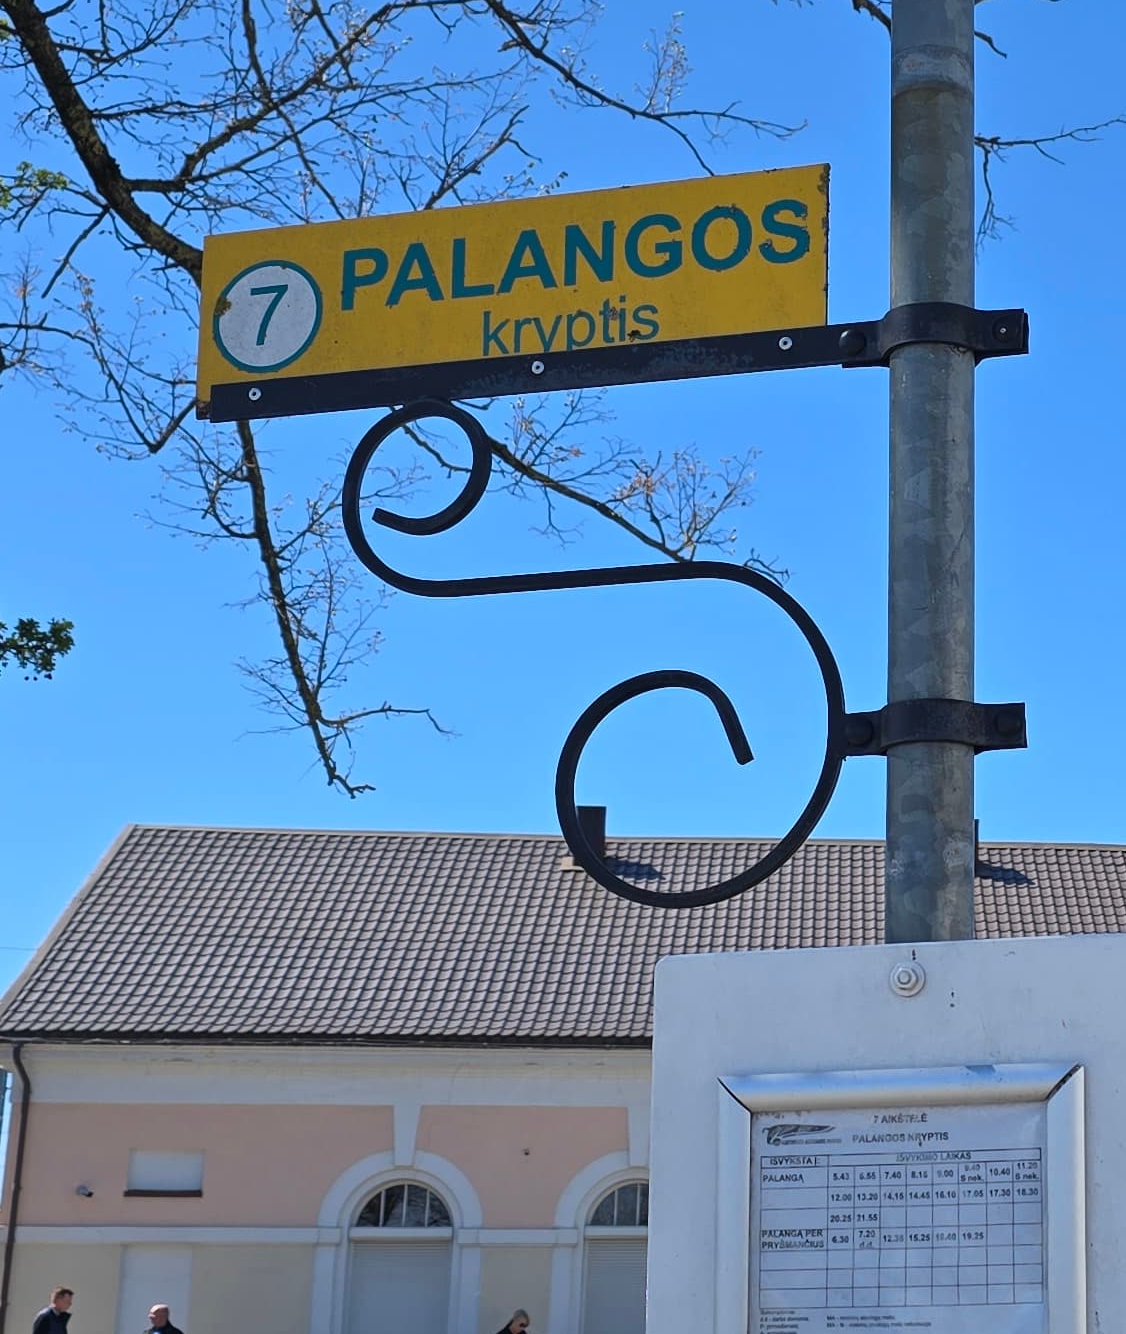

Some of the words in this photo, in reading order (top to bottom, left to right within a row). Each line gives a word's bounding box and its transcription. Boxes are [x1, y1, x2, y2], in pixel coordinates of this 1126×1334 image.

[341, 199, 811, 310] PALANGOS
[250, 284, 290, 346] 7
[482, 296, 660, 356] kryptis
[852, 1134, 905, 1143] PALANGOS
[885, 1171, 902, 1179] 7.40
[989, 1168, 1010, 1176] 10.40
[990, 1188, 1010, 1197] 17.30
[857, 1213, 878, 1221] 21.55
[806, 1229, 823, 1237] PER
